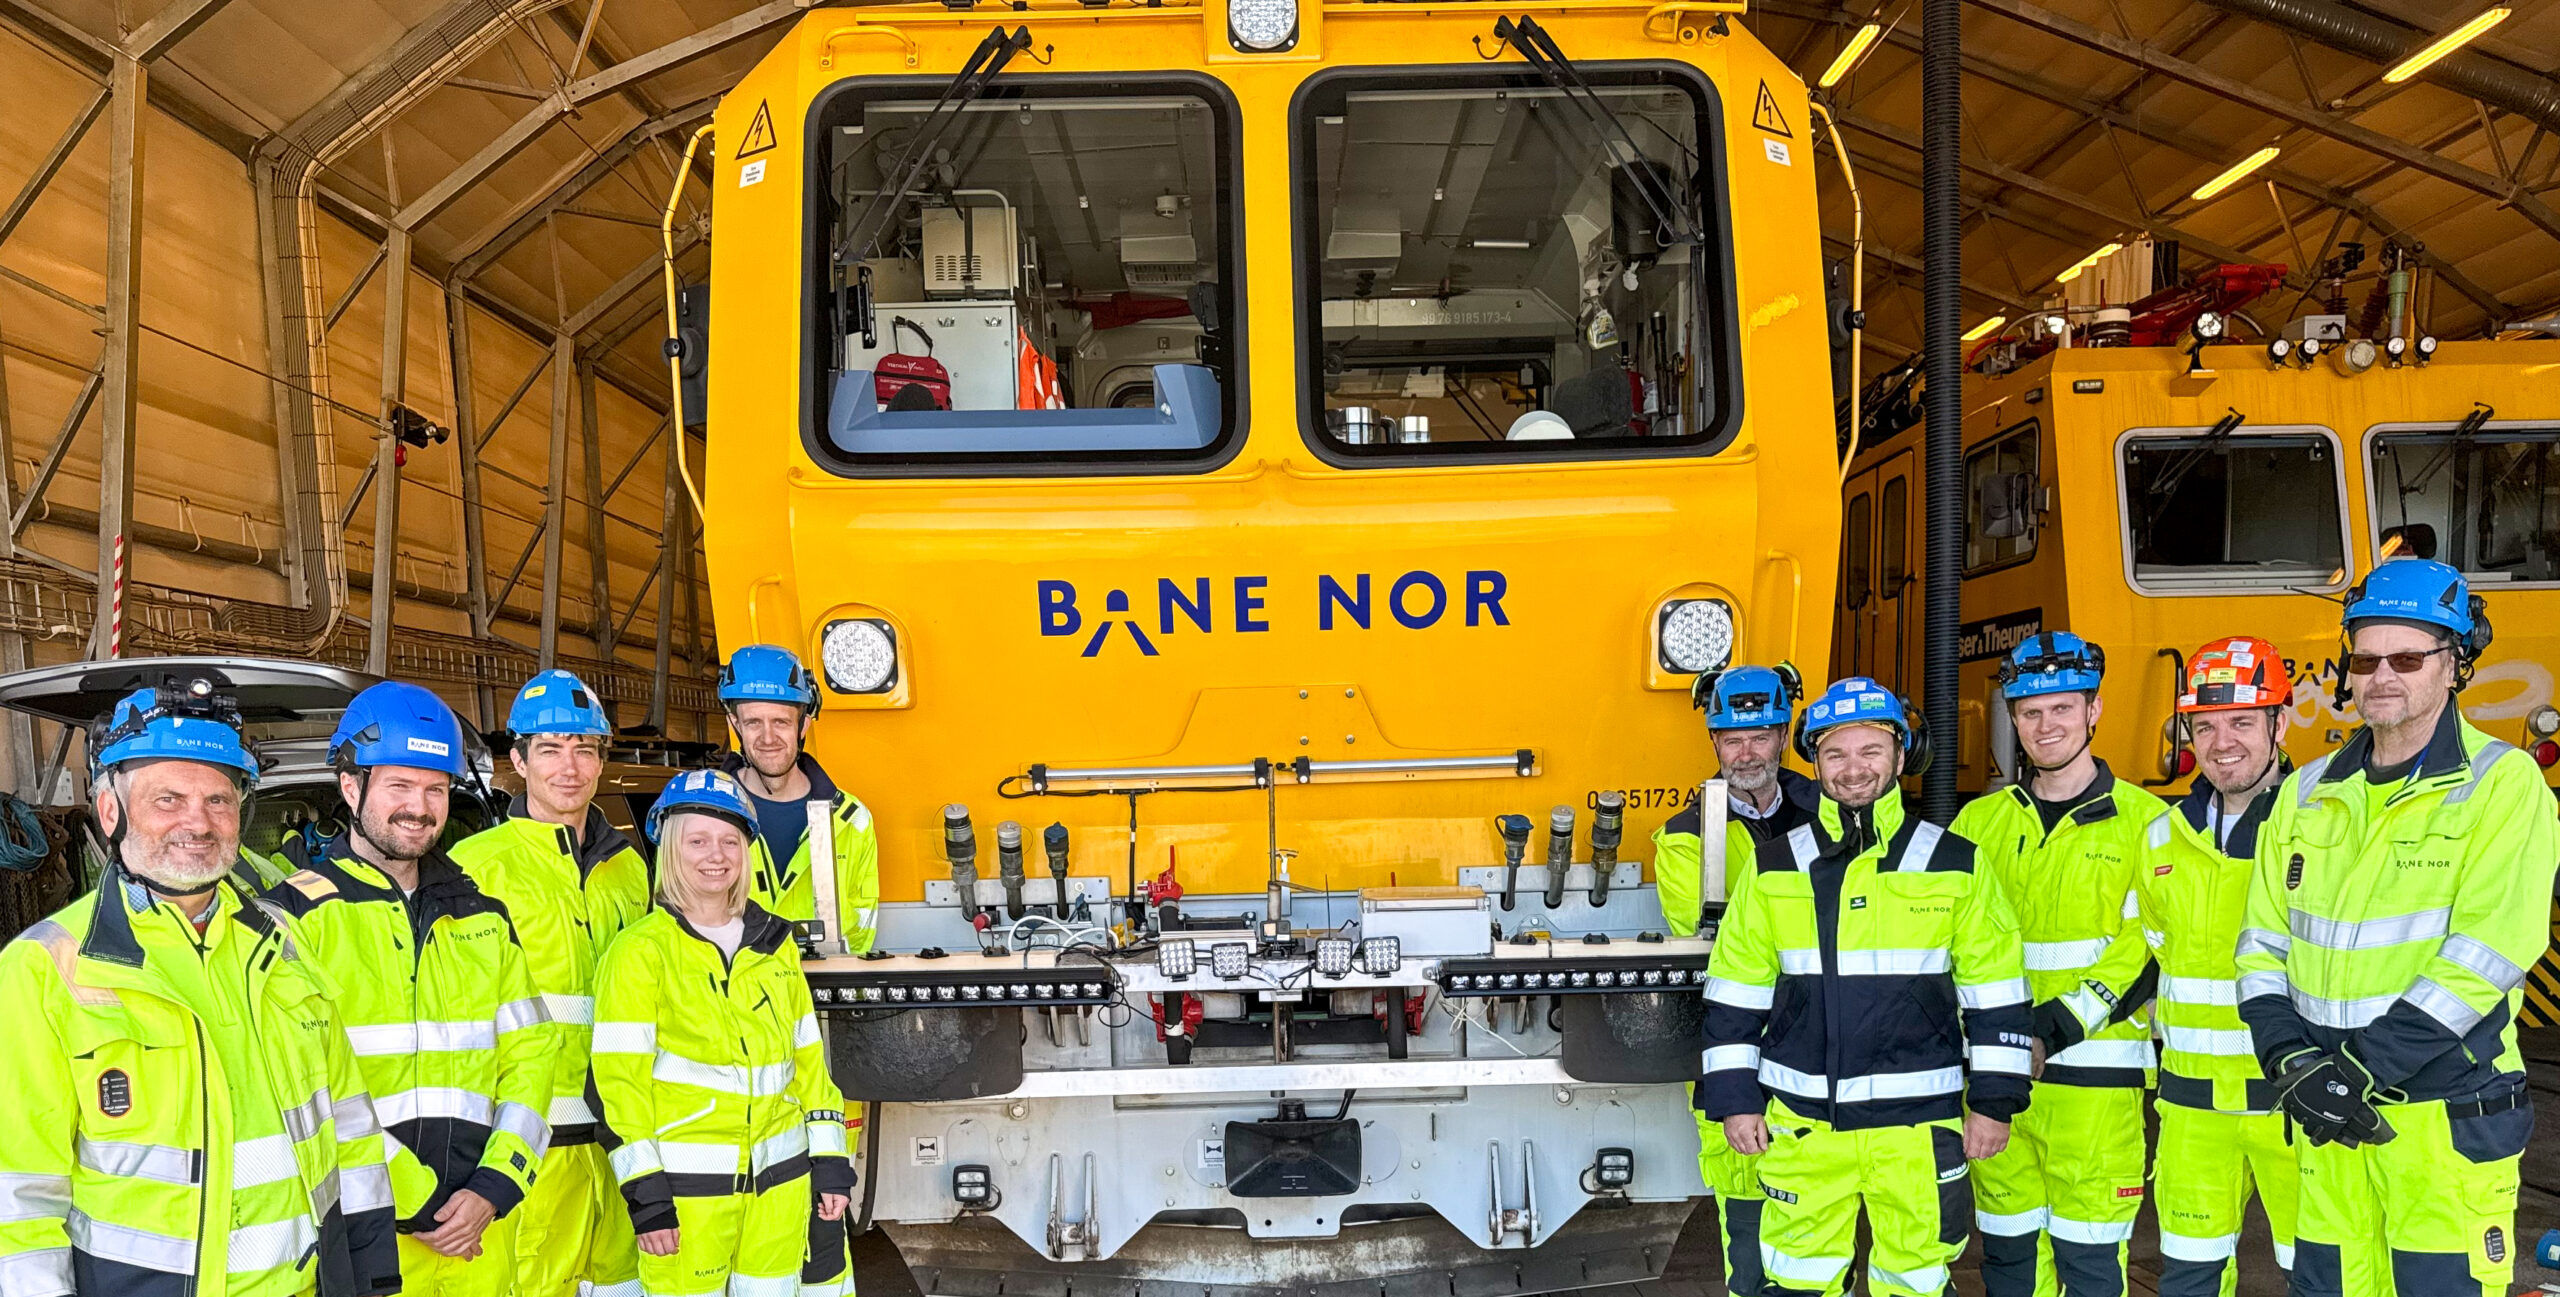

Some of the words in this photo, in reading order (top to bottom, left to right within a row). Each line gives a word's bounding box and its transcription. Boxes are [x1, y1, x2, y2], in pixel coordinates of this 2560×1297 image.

[1037, 575, 1270, 658] BANE
[1318, 570, 1511, 631] NOR
[2282, 657, 2340, 687] BAN
[176, 738, 202, 748] BANE
[204, 741, 224, 750] NOR
[2104, 855, 2121, 863] NOR
[2396, 859, 2424, 869] BANE
[2427, 859, 2450, 868] NOR
[1909, 906, 1931, 914] BANE
[475, 927, 498, 939] NOR
